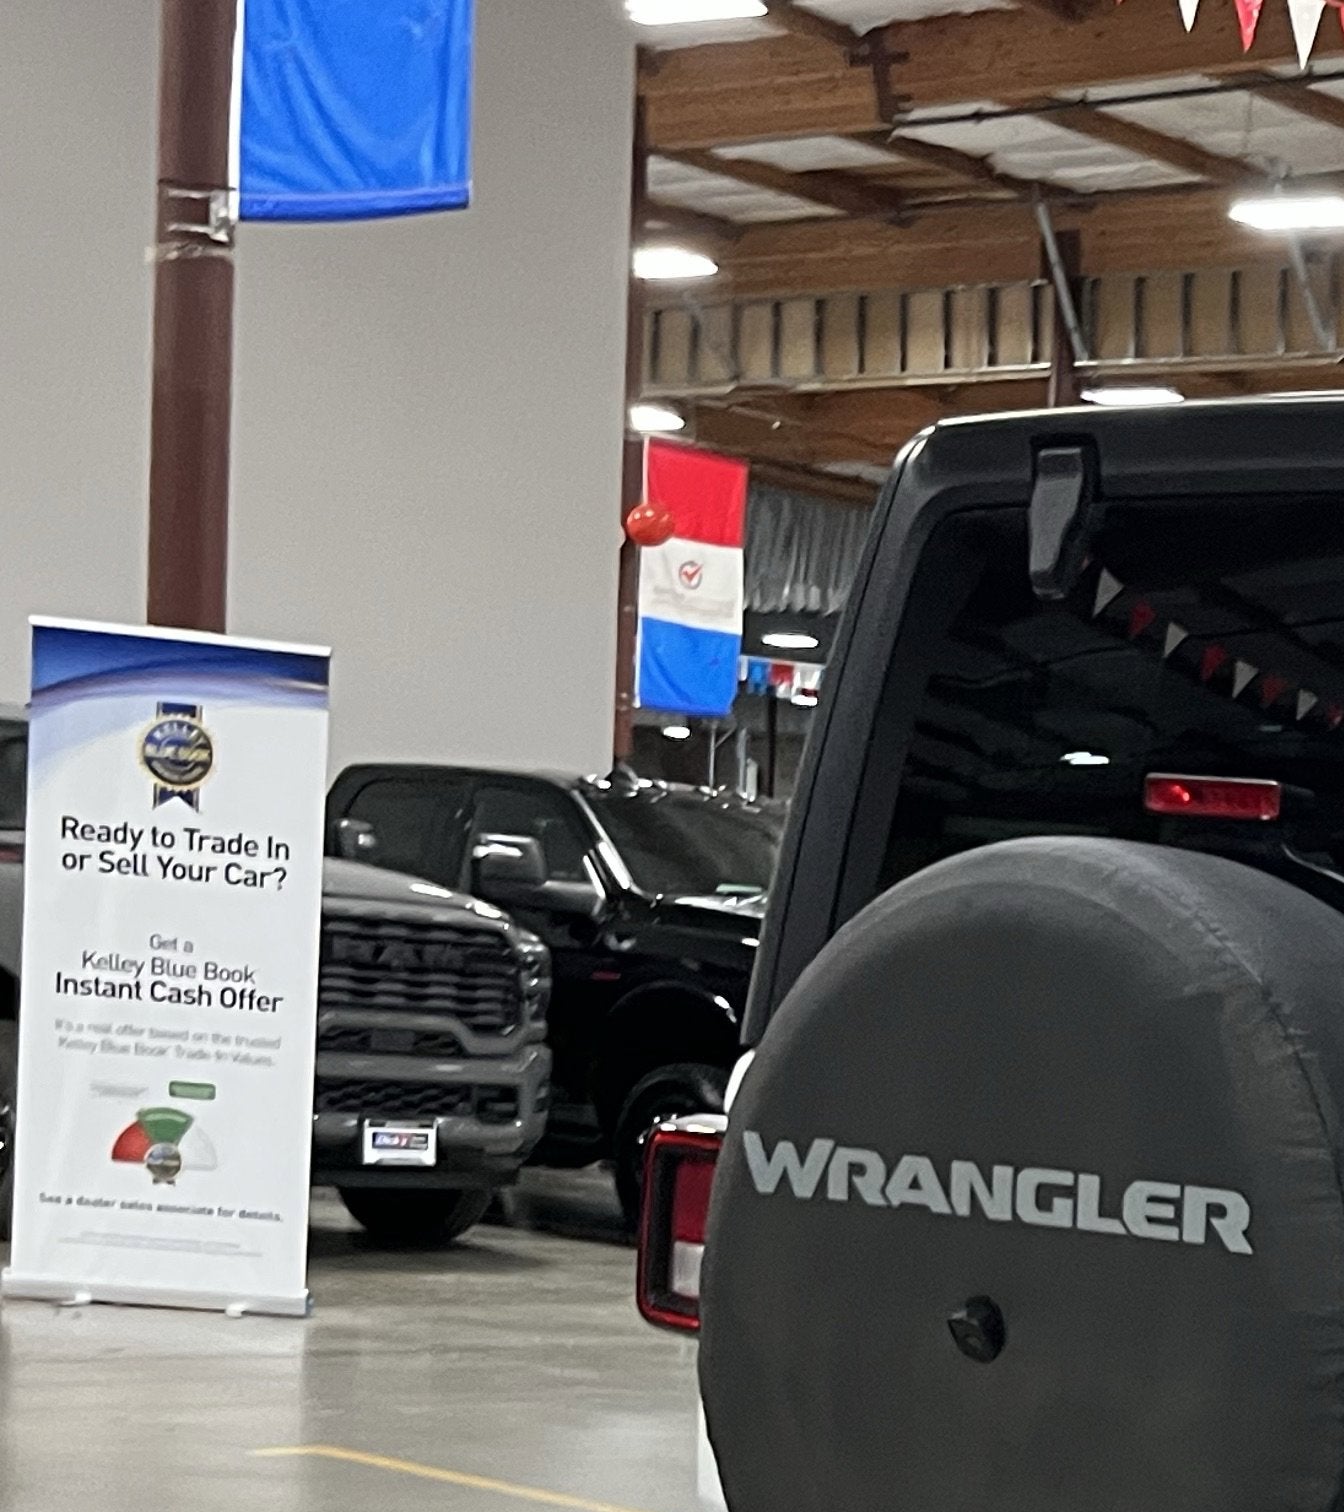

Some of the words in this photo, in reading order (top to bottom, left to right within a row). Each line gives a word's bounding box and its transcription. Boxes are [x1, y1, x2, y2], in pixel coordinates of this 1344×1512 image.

[61, 815, 144, 852] Ready
[151, 826, 175, 849] to
[184, 827, 259, 857] Trade
[267, 836, 290, 861] In
[62, 852, 92, 871] or
[99, 851, 149, 877] Sell
[157, 855, 217, 882] Your
[224, 862, 287, 890] Car?
[150, 934, 177, 951] Get
[183, 940, 194, 953] a
[82, 950, 145, 978] Kelley
[151, 956, 197, 979] Blue
[204, 961, 257, 985] Book
[56, 972, 143, 1001] Instant
[150, 980, 212, 1007] Cash
[219, 987, 284, 1013] Offer
[742, 1130, 1253, 1255] WRANGLER
